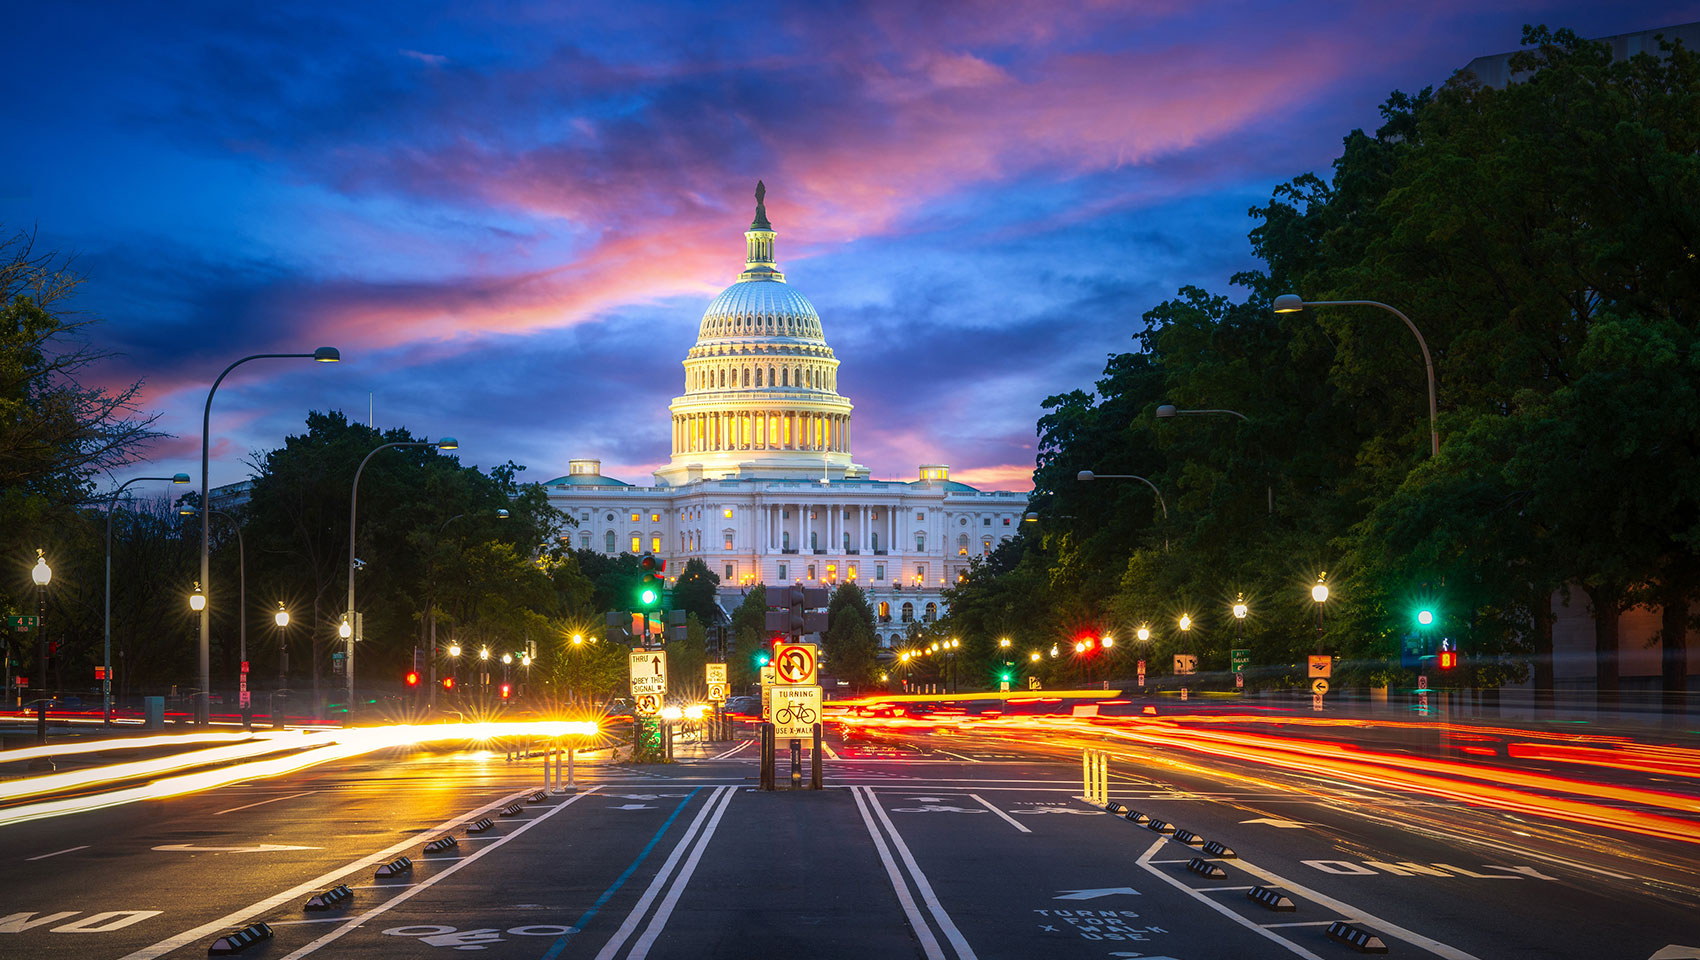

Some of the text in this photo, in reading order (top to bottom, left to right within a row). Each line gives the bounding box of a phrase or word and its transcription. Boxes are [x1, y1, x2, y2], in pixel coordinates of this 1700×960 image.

[632, 655, 649, 663] THRU
[633, 676, 664, 685] OBEY THIS
[633, 685, 655, 693] SIGNAL
[775, 727, 814, 735] USE X-WALK
[1299, 859, 1560, 880] ONLY
[1033, 909, 1140, 918] TURNS
[1062, 917, 1127, 926] FOR
[1037, 924, 1169, 934] X WALK
[1079, 932, 1151, 941] USE
